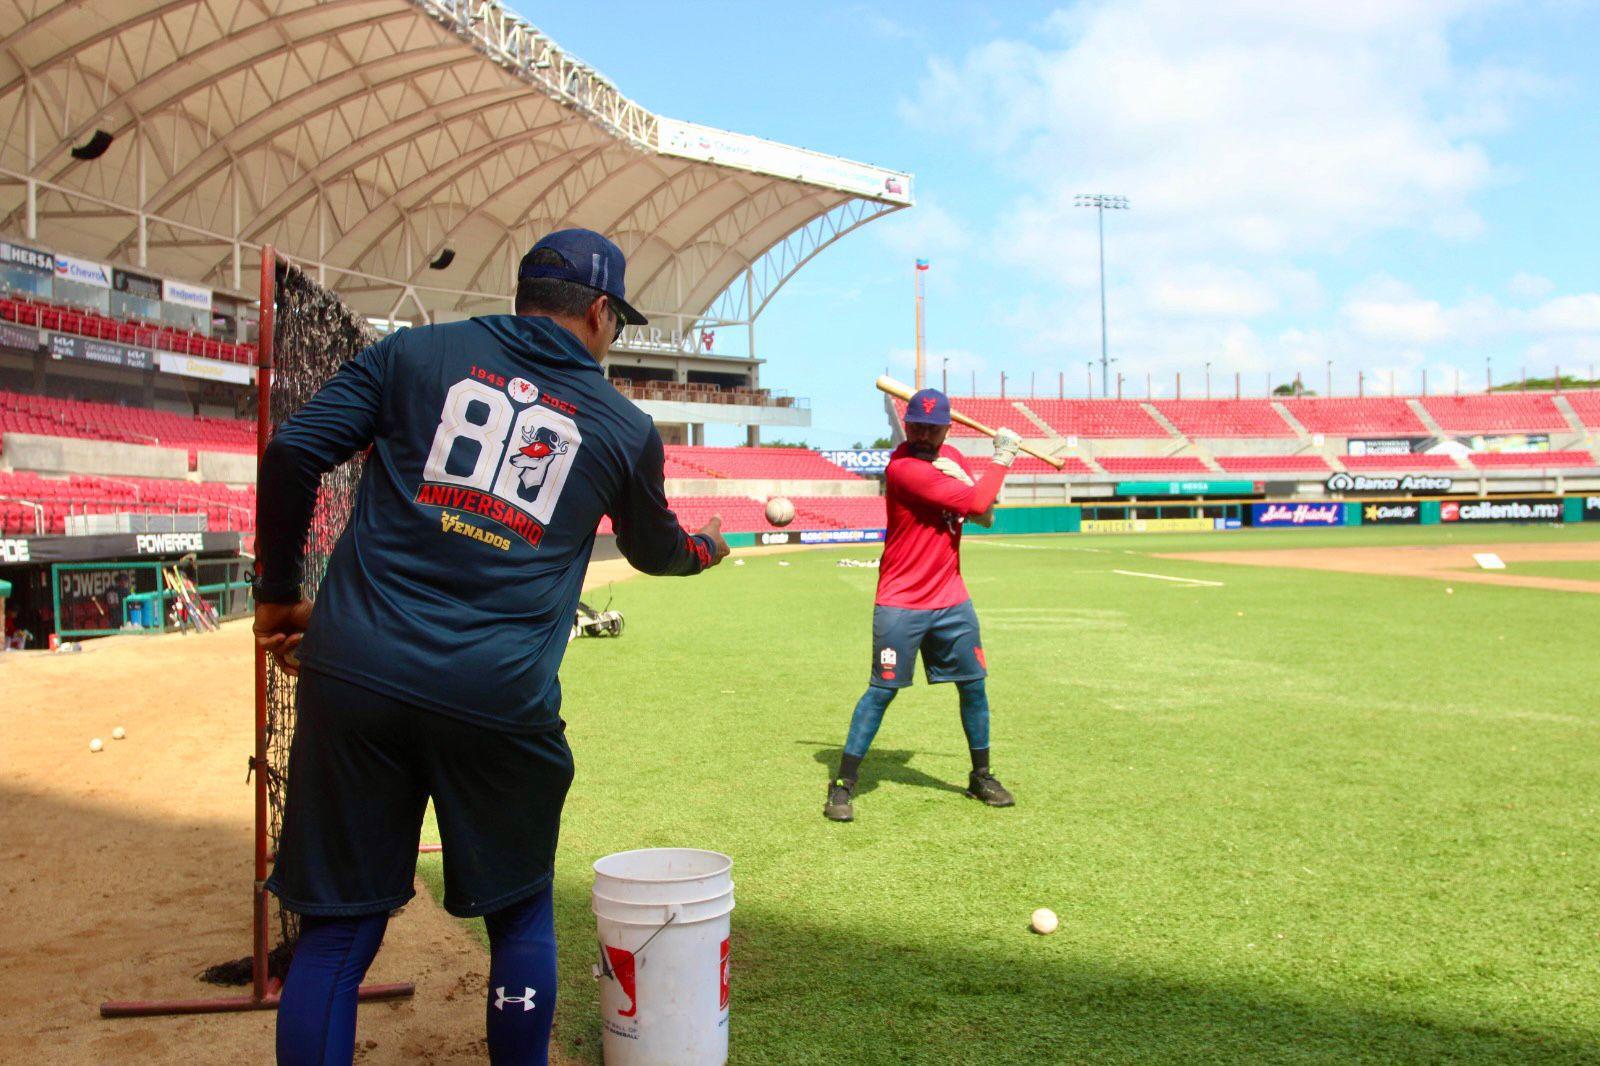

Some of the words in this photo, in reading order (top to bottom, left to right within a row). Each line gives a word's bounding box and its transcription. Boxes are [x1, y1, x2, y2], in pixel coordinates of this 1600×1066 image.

[423, 377, 583, 525] 80
[1354, 476, 1399, 490] Banco
[1400, 475, 1452, 490] Azteca
[417, 485, 543, 545] ANIVERSARIO
[441, 511, 511, 551] VENADOS
[136, 533, 204, 553] POWERADE
